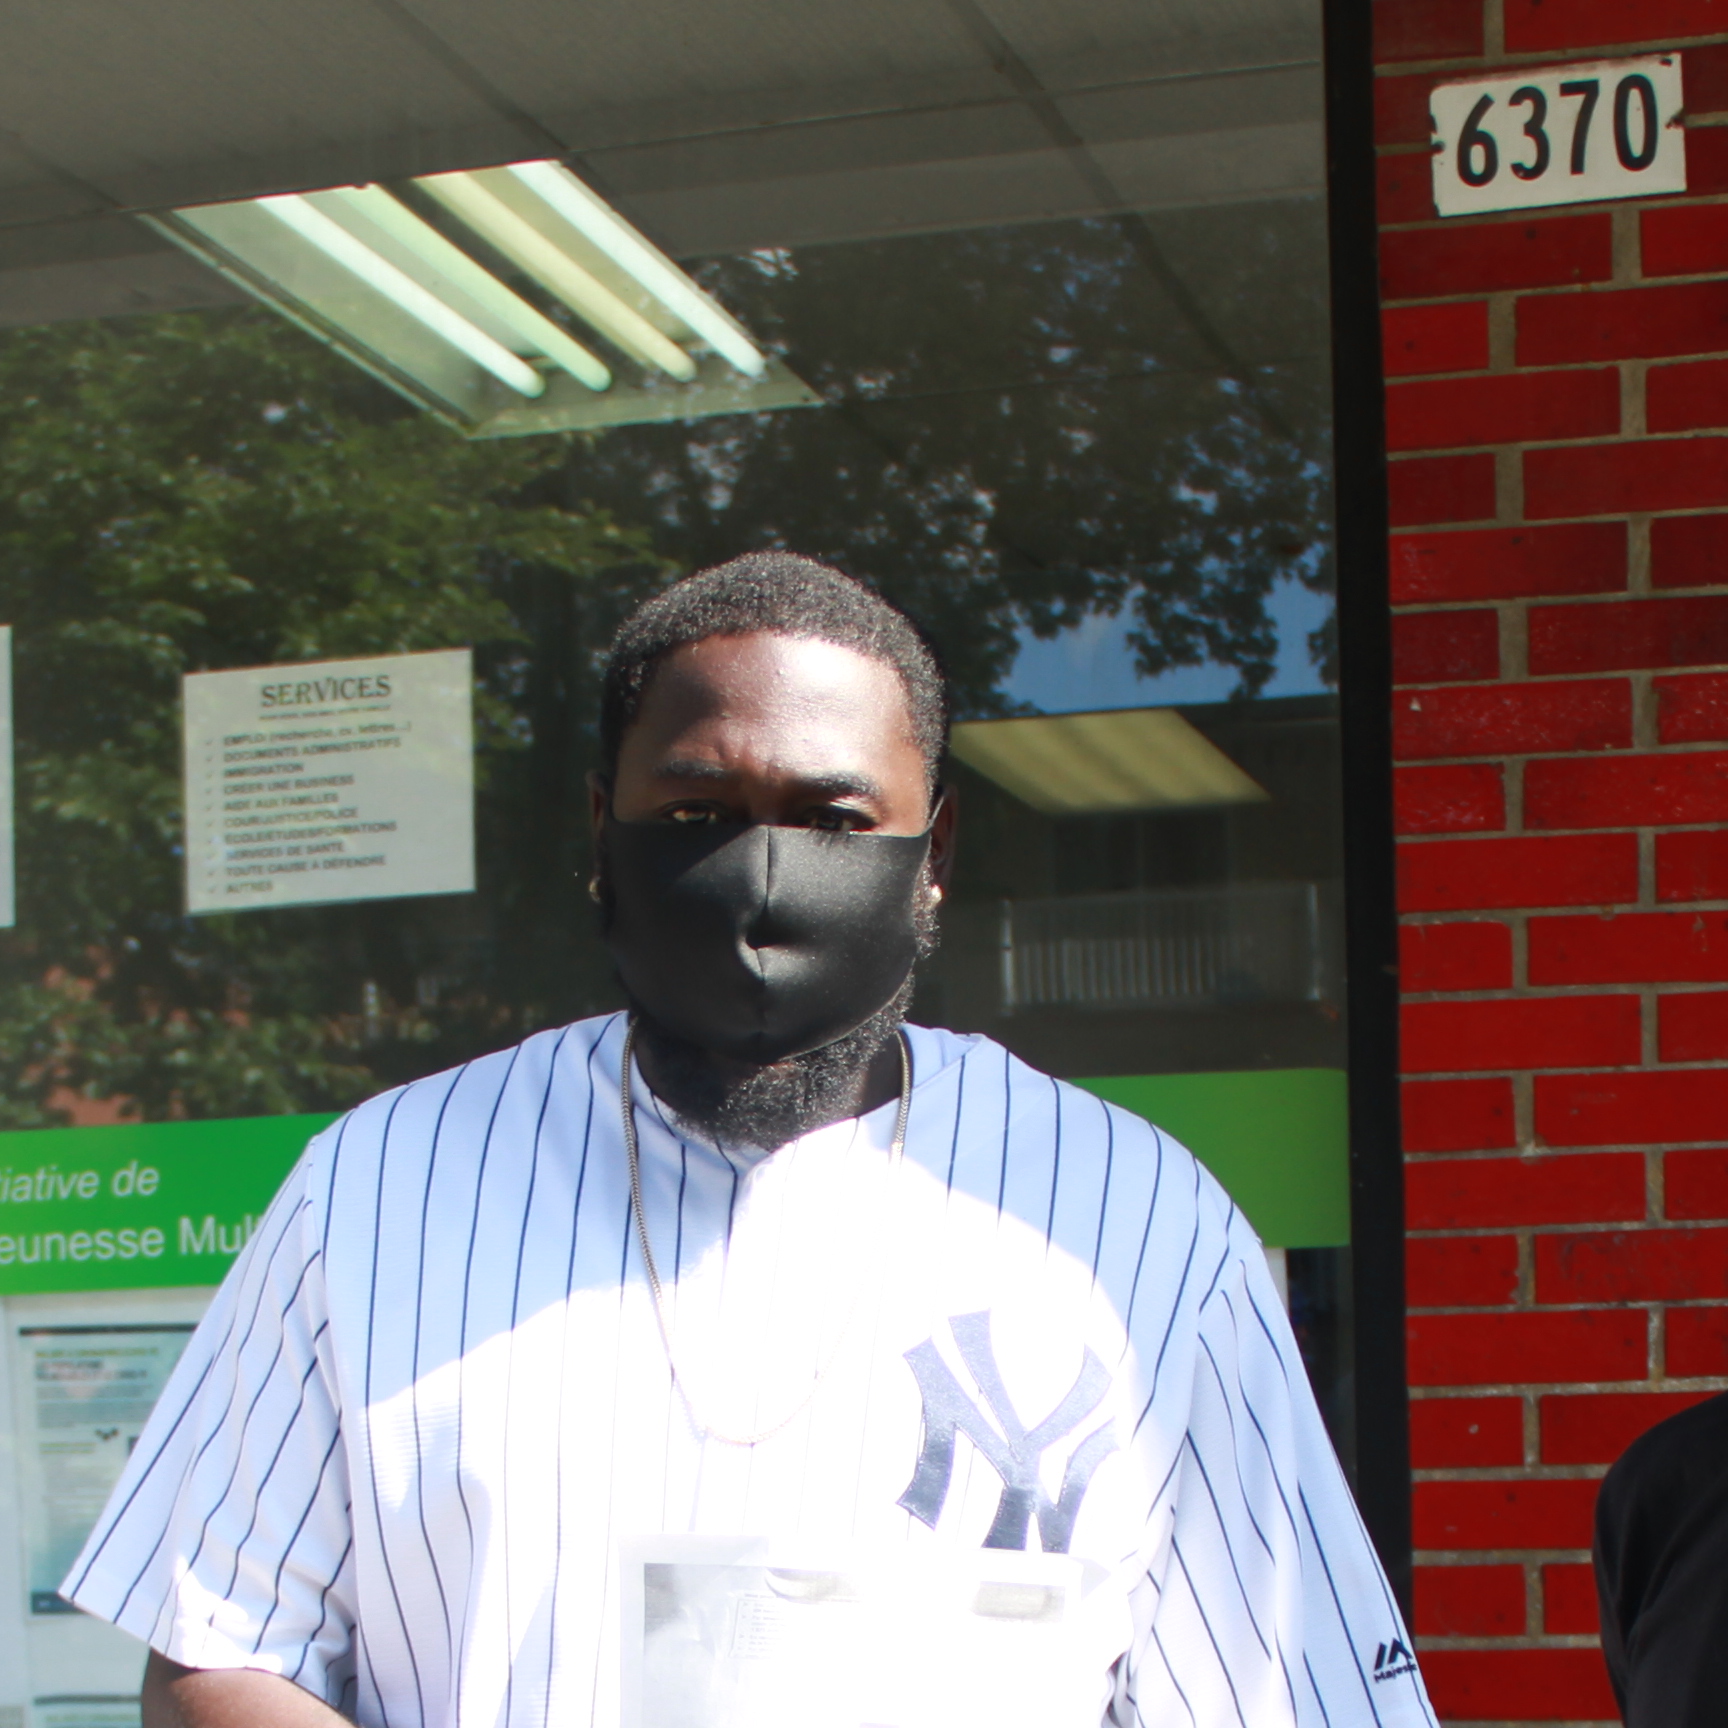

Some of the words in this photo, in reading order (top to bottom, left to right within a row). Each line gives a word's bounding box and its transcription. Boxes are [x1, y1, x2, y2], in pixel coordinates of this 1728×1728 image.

[1457, 74, 1659, 188] 6370
[260, 674, 392, 708] SERVICES
[112, 1160, 160, 1198] de
[895, 1307, 1121, 1555] NY
